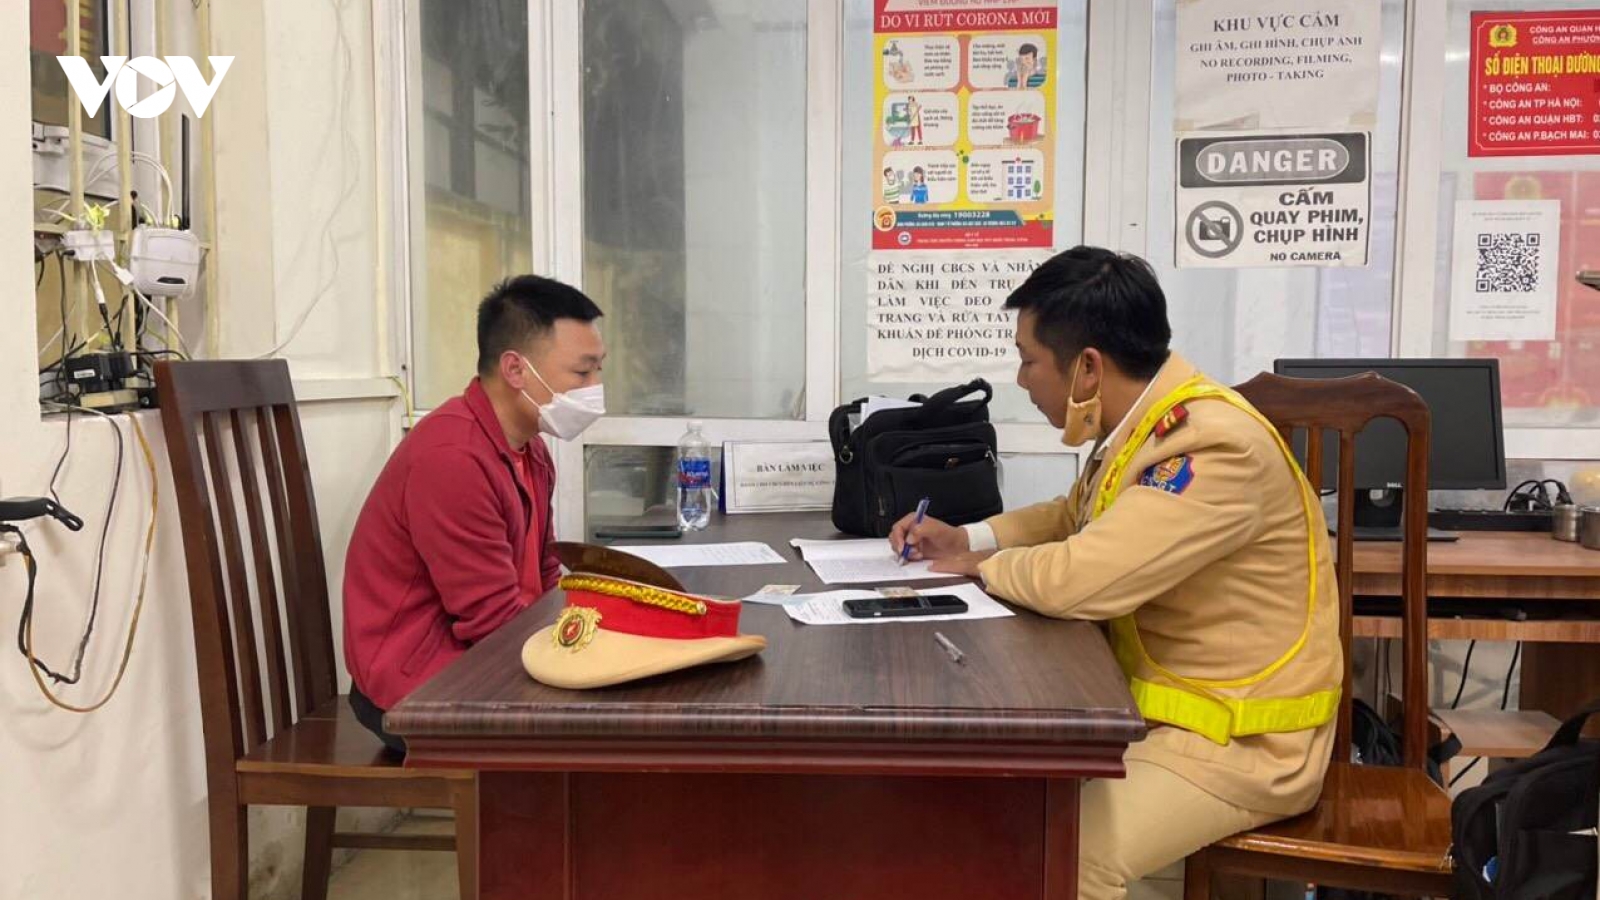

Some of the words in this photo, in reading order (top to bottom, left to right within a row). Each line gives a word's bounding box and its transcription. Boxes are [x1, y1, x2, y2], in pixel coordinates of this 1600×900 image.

[880, 15, 901, 28] DO
[904, 15, 919, 27] VI
[923, 11, 954, 28] RÚT
[956, 12, 1018, 27] CORONA
[1021, 9, 1050, 25] MỚI
[1213, 17, 1251, 33] KHU
[1257, 15, 1295, 33] VỰC
[1299, 10, 1339, 29] CẤM
[1555, 25, 1568, 34] AN
[1190, 42, 1212, 53] GHI
[1239, 39, 1262, 50] GHI
[1301, 37, 1335, 50] CHỤP
[1559, 35, 1572, 44] AN
[1200, 58, 1218, 69] NO
[1219, 55, 1294, 69] RECORDING,
[1296, 52, 1352, 66] FILMING,
[1485, 50, 1501, 76] SỐ
[1531, 55, 1564, 78] THOẠI
[1226, 72, 1267, 83] PHOTO
[1276, 69, 1324, 82] TAKING
[1505, 80, 1533, 93] CÔNG
[1489, 97, 1516, 109] CÔNG
[1517, 99, 1532, 108] AN
[1533, 99, 1546, 108] TP
[1547, 96, 1561, 108] HÀ
[1488, 113, 1516, 125] CÔNG
[1517, 115, 1532, 125] AN
[1488, 130, 1516, 142] CÔNG
[1517, 132, 1531, 142] AN
[1207, 149, 1338, 175] DANGER
[1278, 186, 1334, 206] CẤM
[1249, 210, 1300, 226] QUAY
[1307, 208, 1364, 225] PHIM,
[1253, 227, 1306, 246] CHỤP
[1312, 224, 1359, 242] HÌNH
[1269, 252, 1287, 261] NO
[1289, 251, 1342, 261] CAMERA
[902, 263, 934, 276] NGHỊ
[941, 262, 975, 273] CBCS
[877, 277, 904, 290] DÂN
[915, 279, 940, 290] KHI
[877, 293, 906, 307] LÀM
[919, 295, 951, 309] VIỆC
[877, 312, 922, 323] TRANG
[986, 312, 1012, 323] TAY
[947, 327, 992, 340] PHÒNG
[912, 346, 944, 359] DỊCH
[947, 346, 1006, 358] COVID-19
